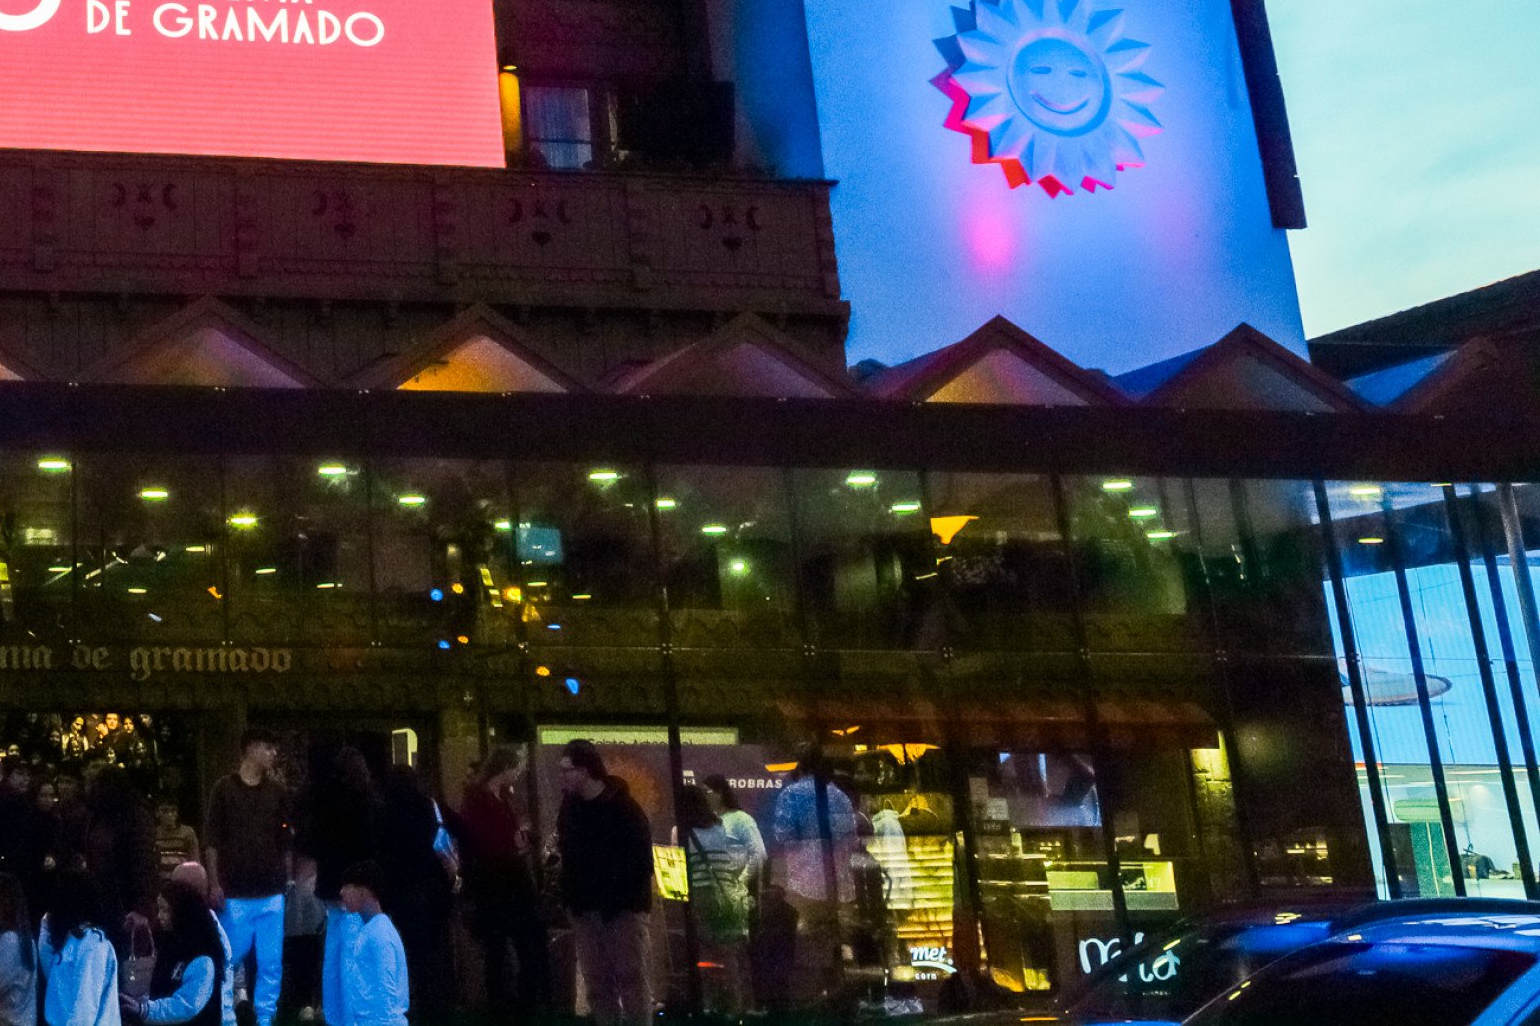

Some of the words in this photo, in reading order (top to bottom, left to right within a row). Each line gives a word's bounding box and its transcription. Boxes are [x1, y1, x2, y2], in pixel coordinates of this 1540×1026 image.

[88, 0, 132, 36] DE
[153, 3, 386, 48] GRAMADO
[72, 644, 111, 670] de
[129, 645, 292, 681] gramado
[726, 778, 783, 789] ROBRAS
